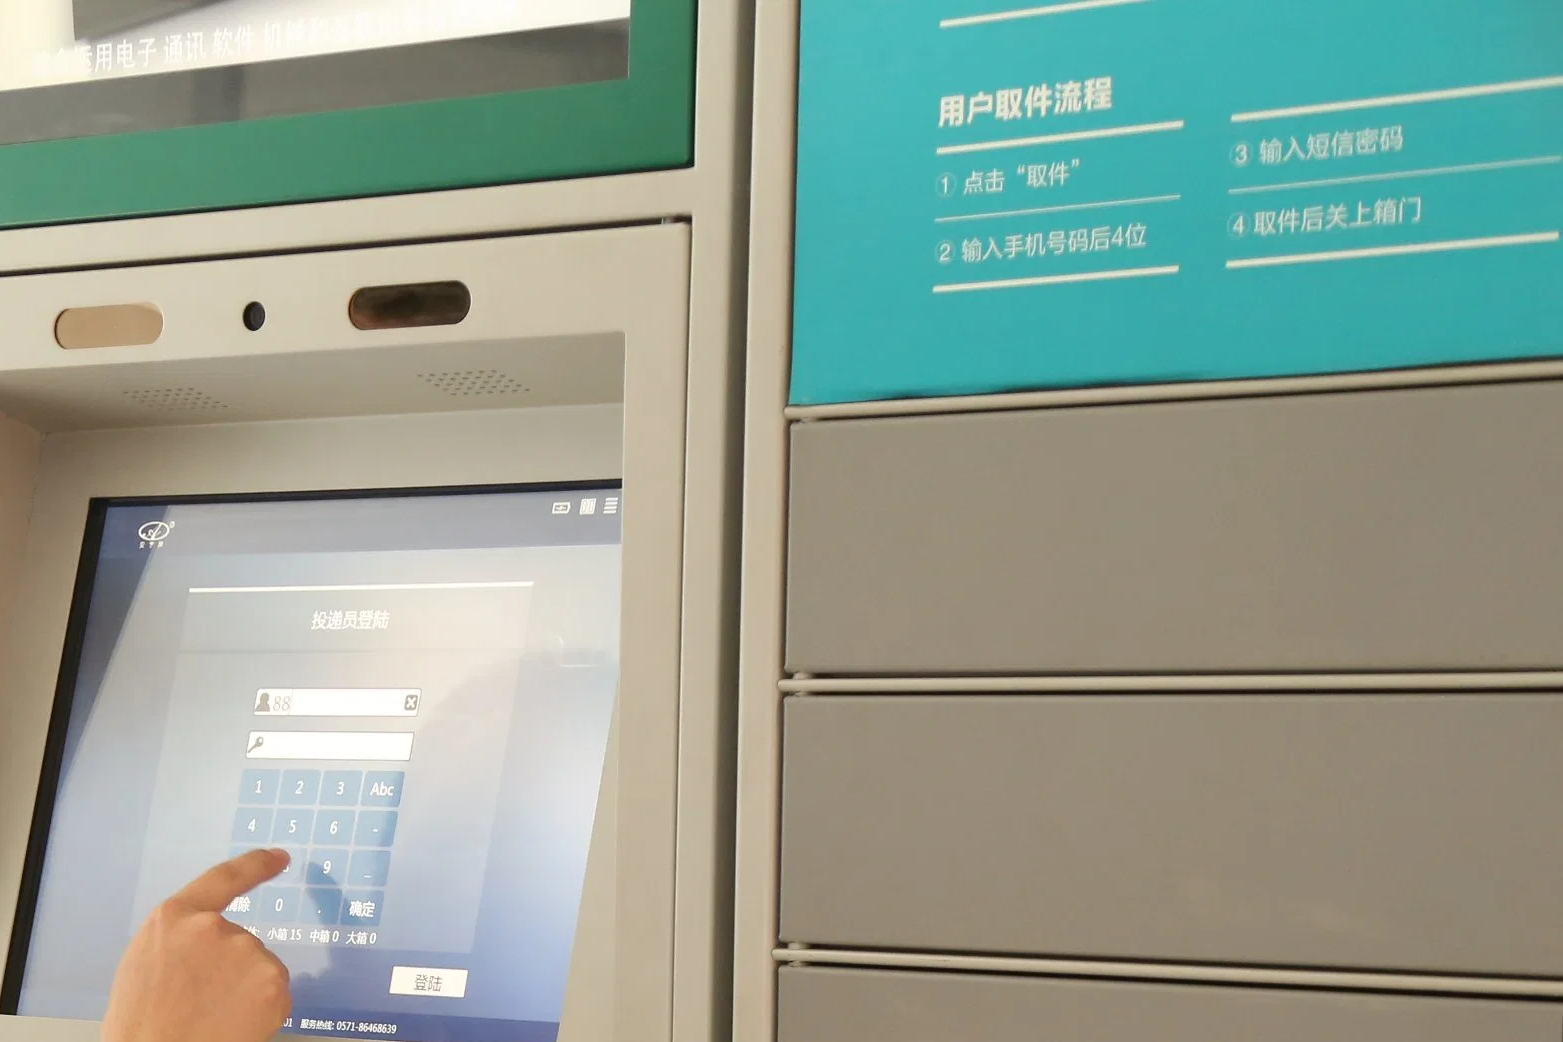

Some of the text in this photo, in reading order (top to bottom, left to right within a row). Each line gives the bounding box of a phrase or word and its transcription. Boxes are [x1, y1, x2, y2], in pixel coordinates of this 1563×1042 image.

[164, 31, 205, 64] 通讯
[213, 23, 256, 58] 软件
[939, 76, 1112, 127] 用户取件流程
[1259, 125, 1403, 165] 输入短信密码
[1253, 196, 1422, 236] 取件后关上箱门
[961, 222, 1147, 262] 输入手机号码后4位
[311, 609, 390, 630] 投递员登陆
[254, 780, 395, 796] 1 2 3 Abc
[247, 818, 256, 832] 4
[288, 819, 297, 833] 5
[329, 820, 338, 834] 6
[322, 860, 332, 874] 9
[275, 898, 283, 912] 0
[349, 900, 375, 918] 确定
[266, 927, 288, 941] 小箱
[289, 928, 302, 941] 15
[309, 929, 331, 943] 中箱
[332, 930, 340, 942] 0
[345, 931, 367, 945] 大箱
[369, 932, 377, 944] 0
[413, 974, 443, 992] 登陆
